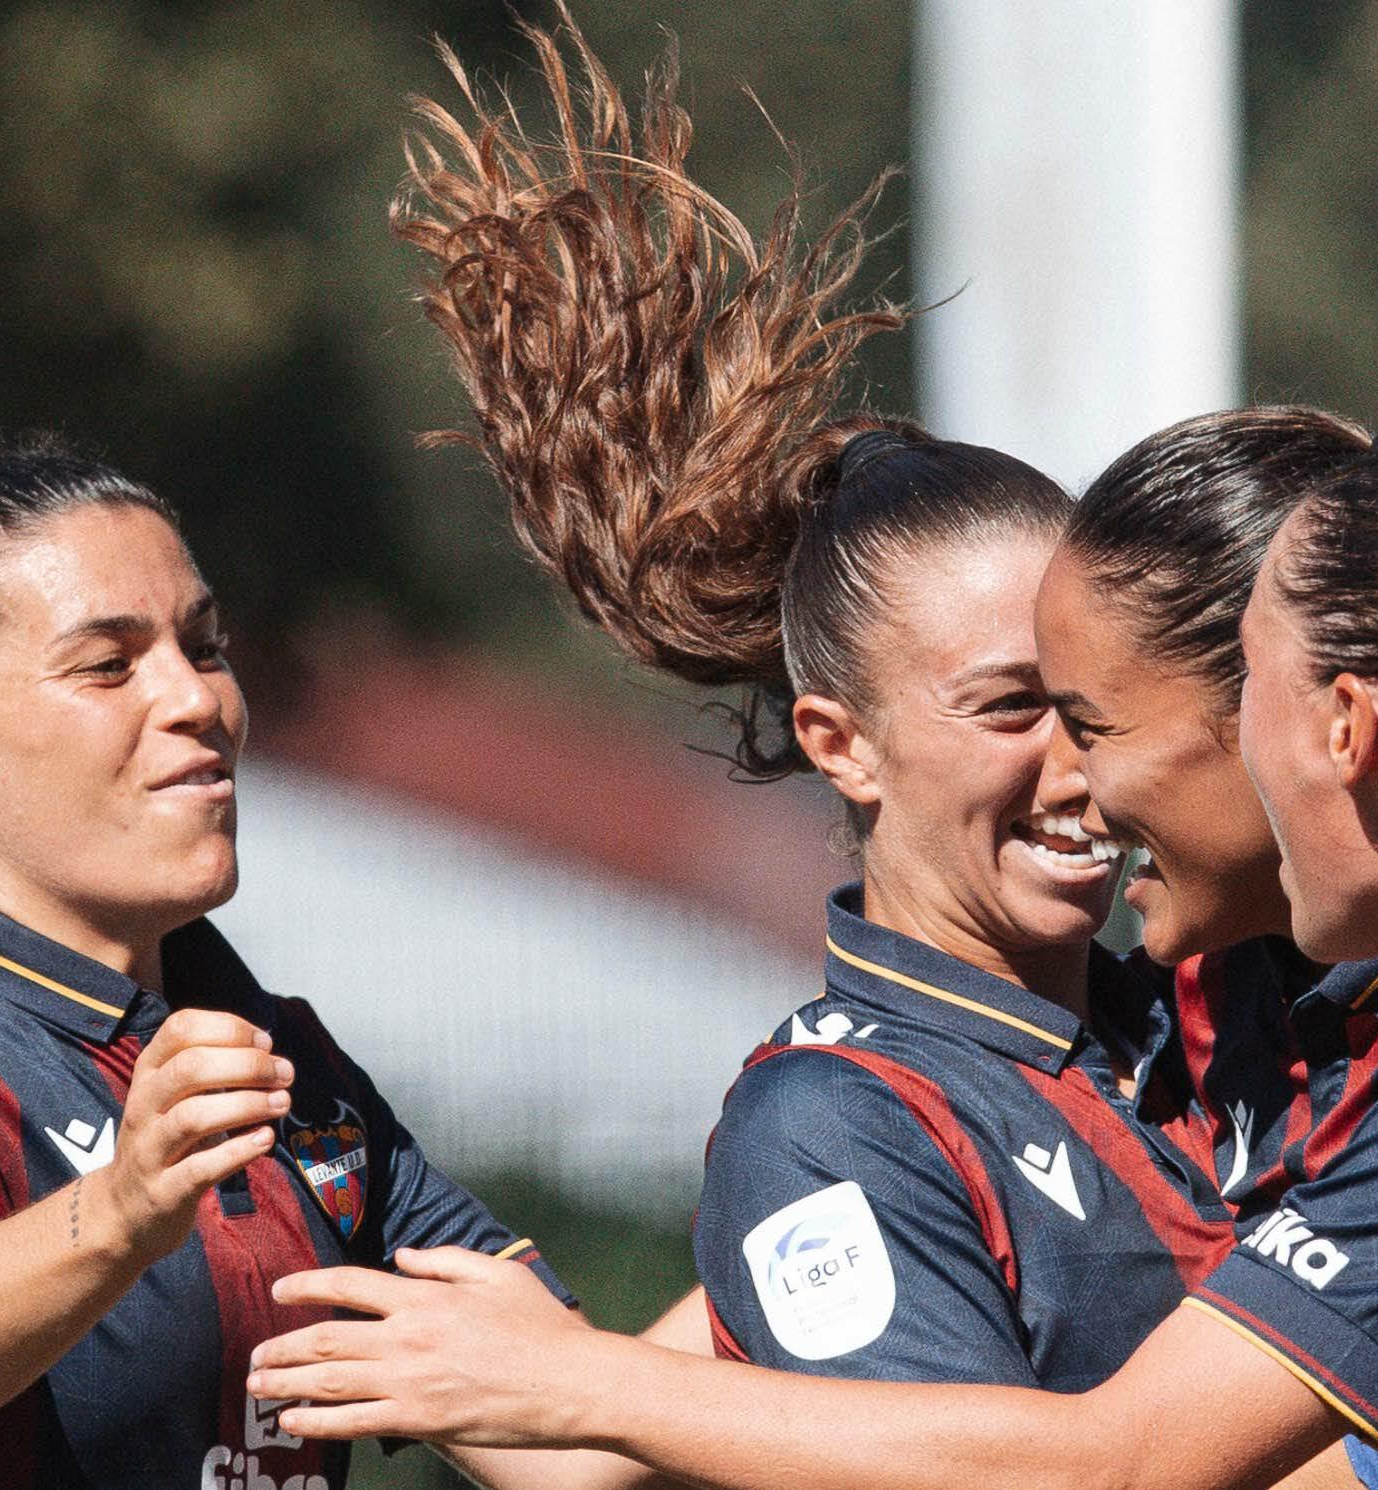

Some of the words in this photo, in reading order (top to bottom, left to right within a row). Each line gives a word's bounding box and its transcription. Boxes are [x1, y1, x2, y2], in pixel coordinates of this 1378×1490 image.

[782, 1258, 841, 1296] Liga
[844, 1244, 861, 1269] F
[1240, 1207, 1351, 1291] ika
